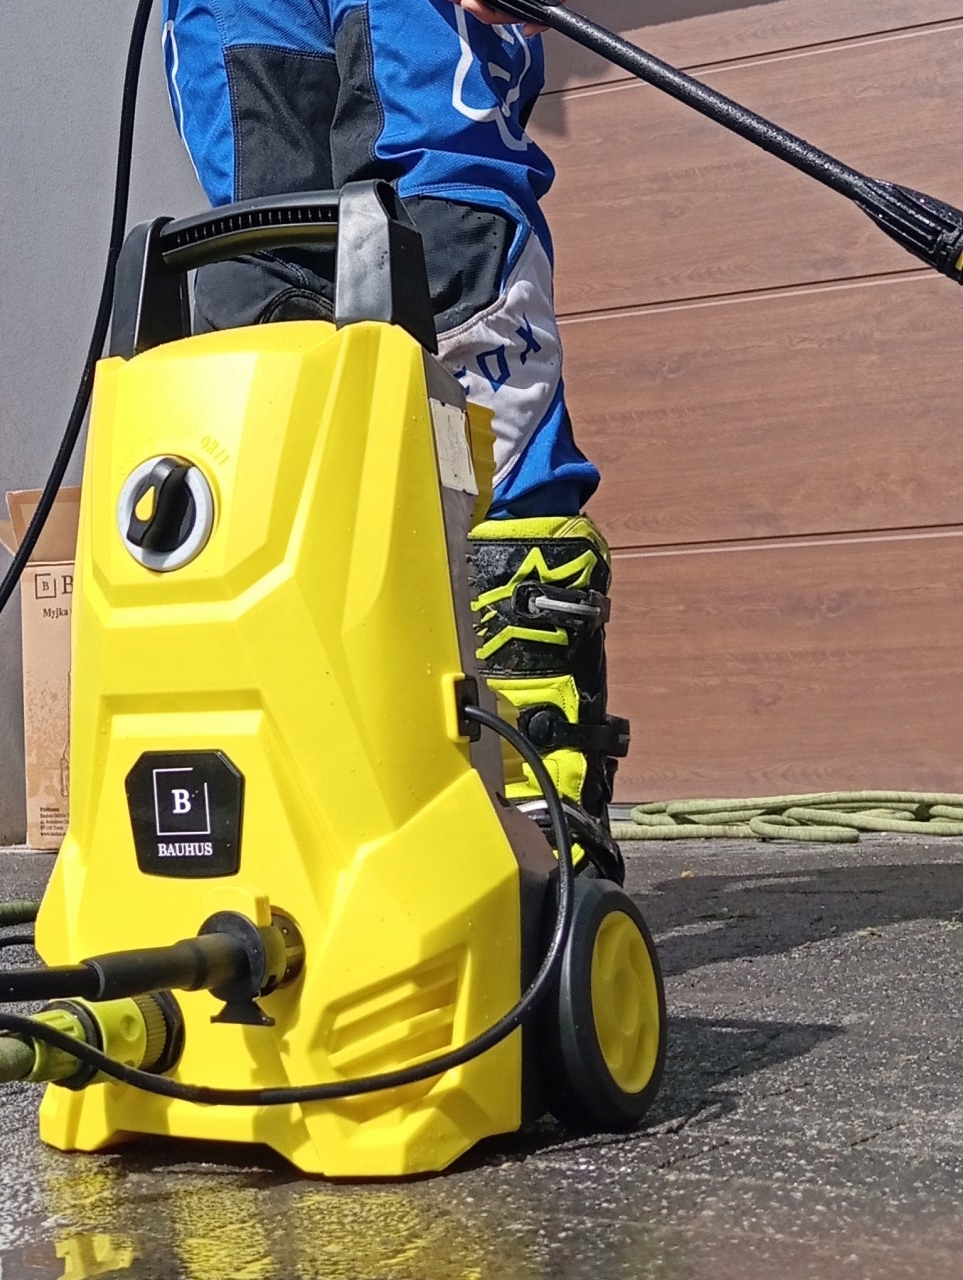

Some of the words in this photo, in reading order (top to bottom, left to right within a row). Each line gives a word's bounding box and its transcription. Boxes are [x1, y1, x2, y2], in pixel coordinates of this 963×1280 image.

[43, 608, 69, 619] Myjka
[171, 789, 191, 814] B
[157, 842, 213, 857] BAUHUS
